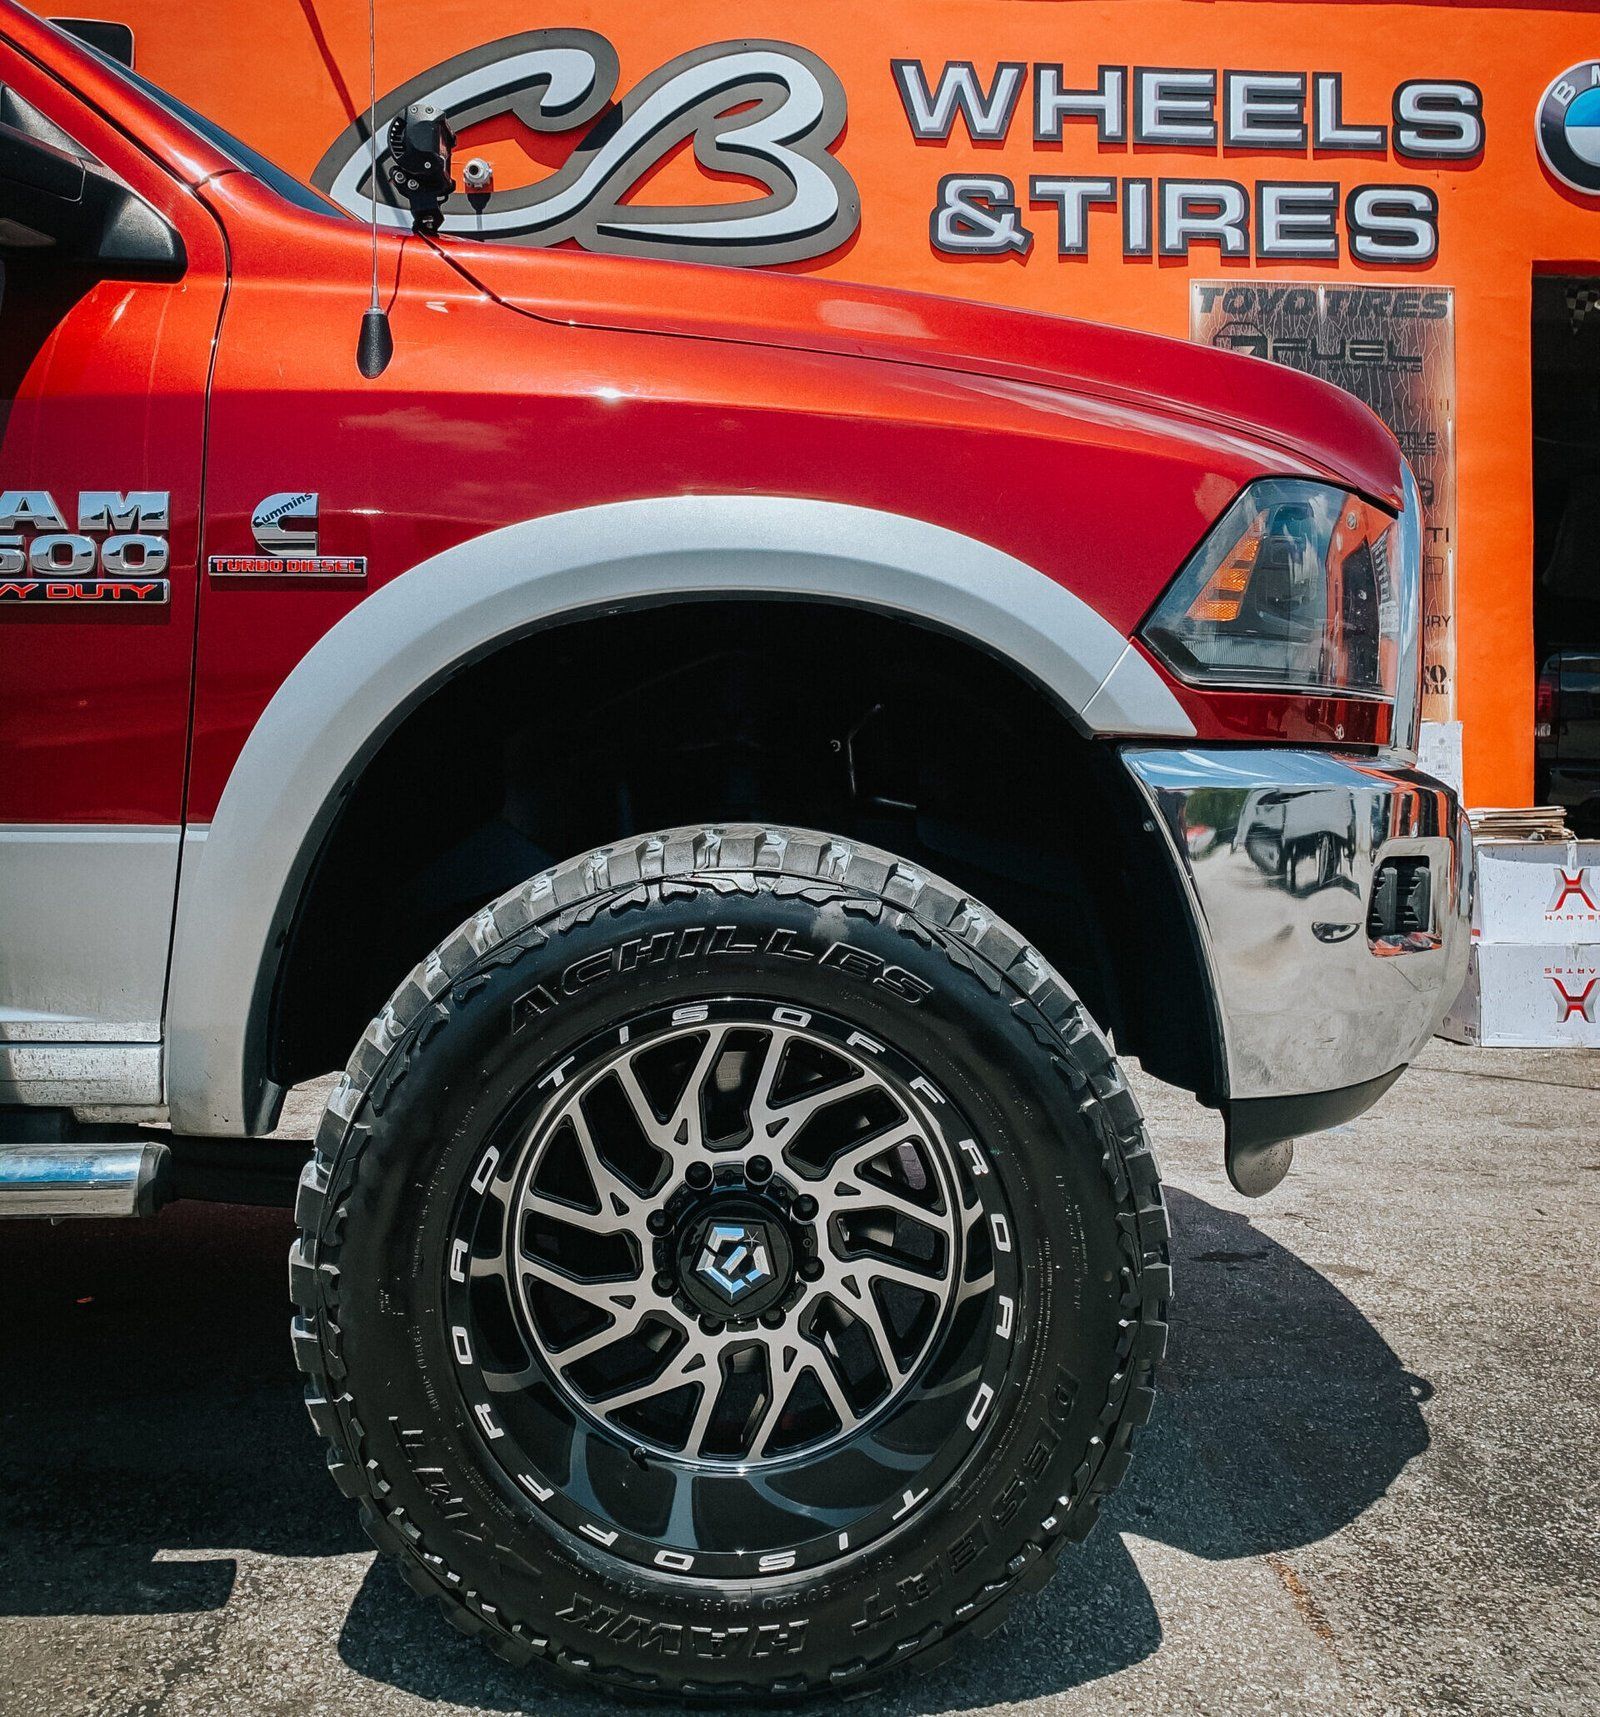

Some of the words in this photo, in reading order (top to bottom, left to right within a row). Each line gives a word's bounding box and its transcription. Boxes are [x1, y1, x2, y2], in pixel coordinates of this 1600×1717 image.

[890, 58, 1485, 159] WHEELS
[313, 30, 858, 262] CB
[0, 491, 170, 531] AM
[252, 492, 313, 528] Cummins
[46, 583, 158, 599] DUTY
[212, 558, 284, 573] TURBO
[286, 559, 362, 573] DIESEL
[511, 925, 935, 1038] ACHILLES
[850, 1363, 1081, 1636] DESERT
[554, 1591, 811, 1660] HAWK
